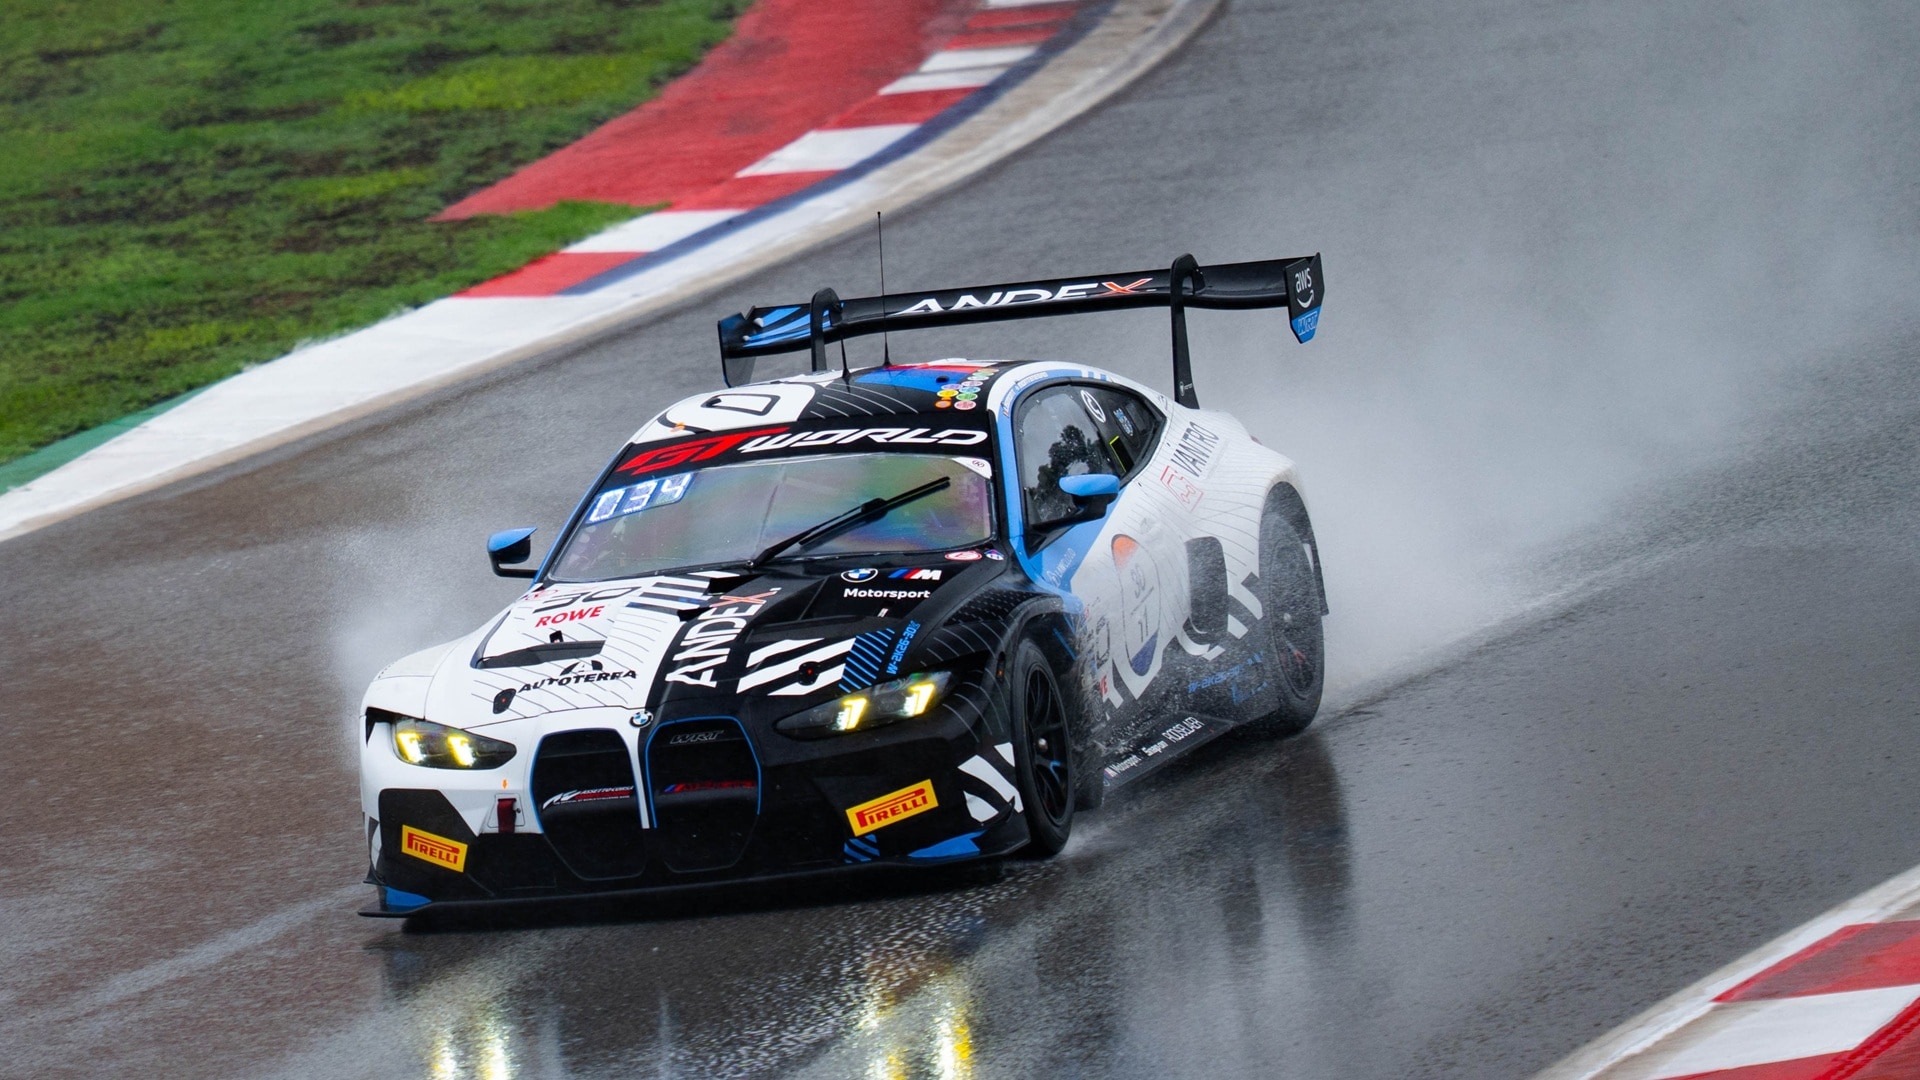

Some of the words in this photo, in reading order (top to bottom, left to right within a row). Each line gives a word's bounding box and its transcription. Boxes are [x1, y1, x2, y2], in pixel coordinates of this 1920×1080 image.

[892, 278, 1153, 316] ANDEX
[1295, 267, 1313, 293] aws
[615, 427, 790, 476] GT
[737, 428, 988, 454] WORLD
[1170, 421, 1219, 477] VANTRO
[589, 472, 693, 522] 034
[843, 588, 931, 600] Motorsport
[534, 605, 605, 628] ROWE
[665, 590, 778, 688] ANDEX
[518, 670, 637, 693] AUTOTERRA
[855, 788, 928, 828] PIRELLI
[406, 832, 460, 864] PIRELLI
